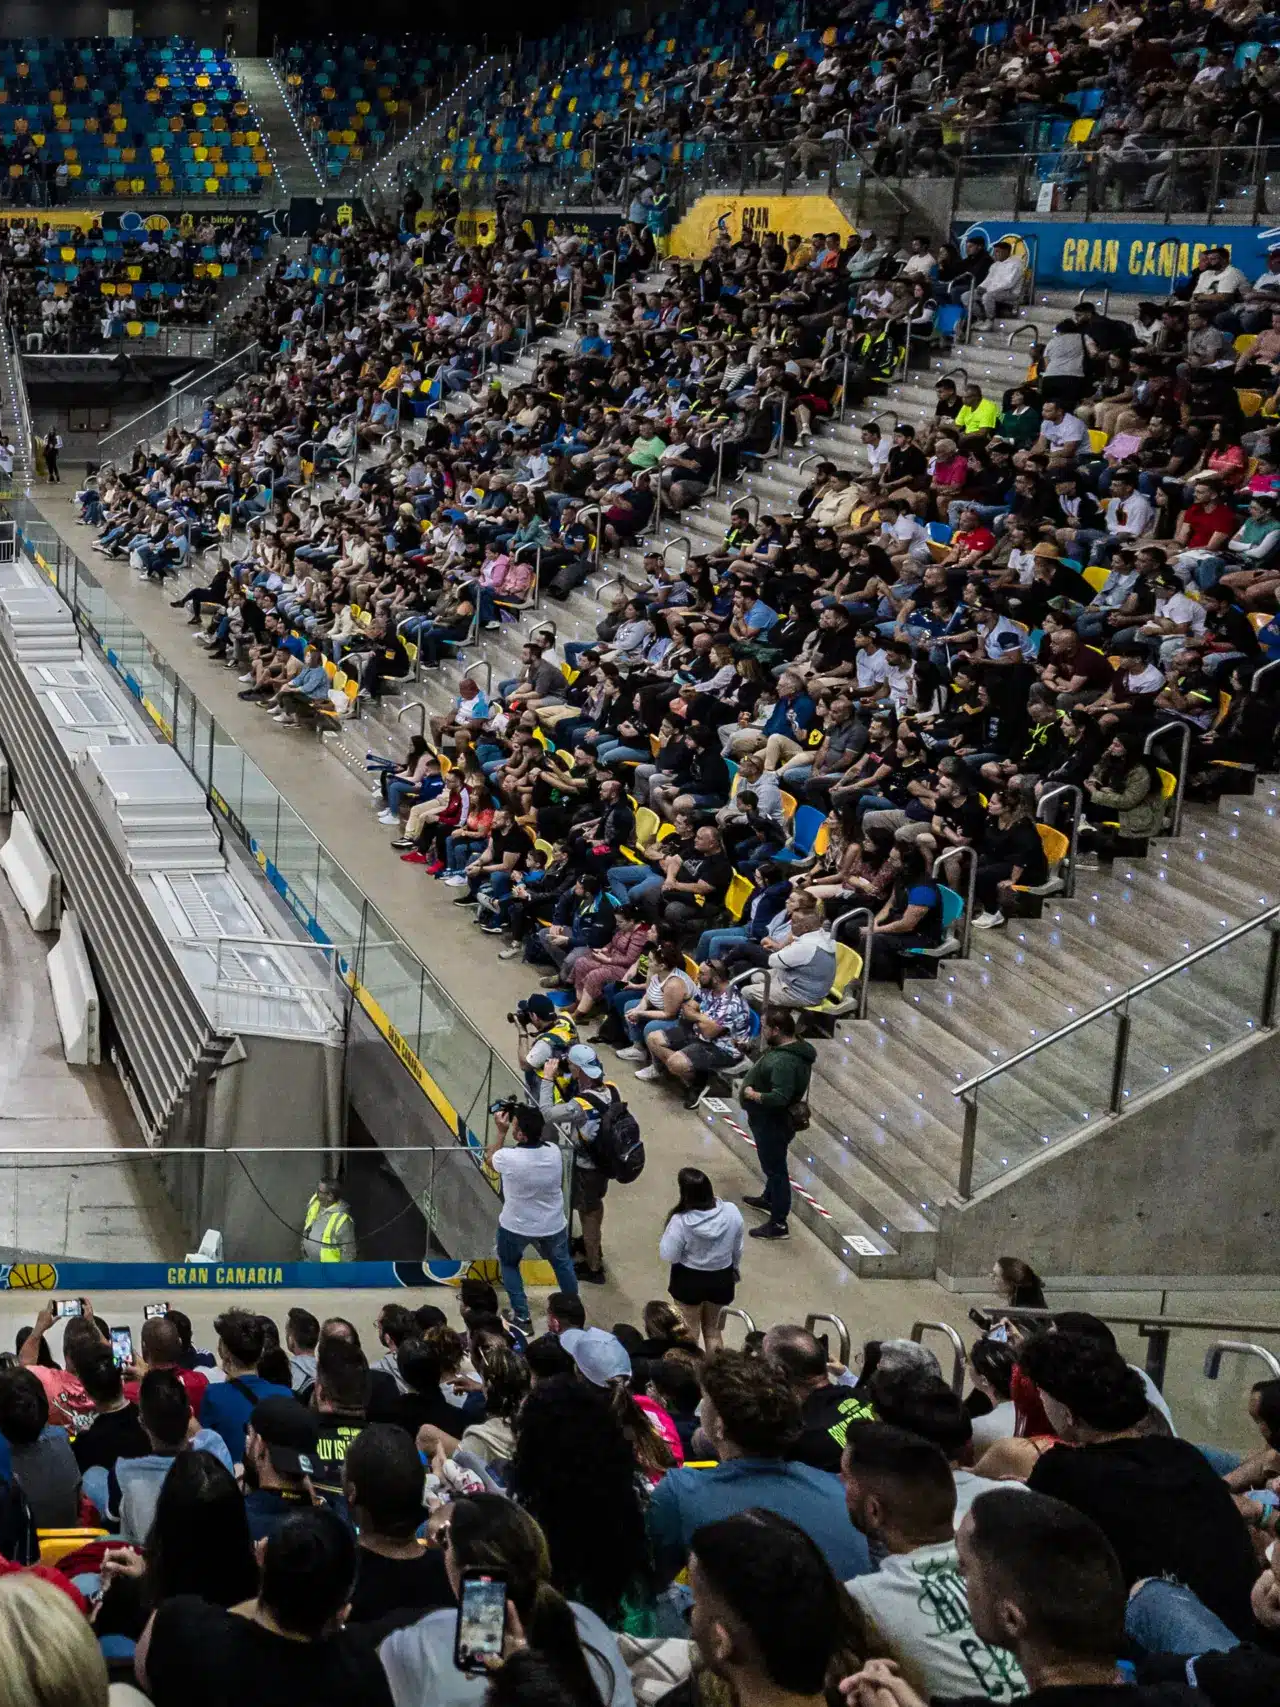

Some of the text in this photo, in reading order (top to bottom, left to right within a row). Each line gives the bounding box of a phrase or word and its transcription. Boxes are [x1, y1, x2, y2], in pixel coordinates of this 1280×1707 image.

[200, 215, 234, 224] Cbildo
[742, 207, 769, 228] GRAN
[1062, 238, 1233, 277] GRAN CANAR
[167, 1266, 284, 1285] GRAN CANARIA
